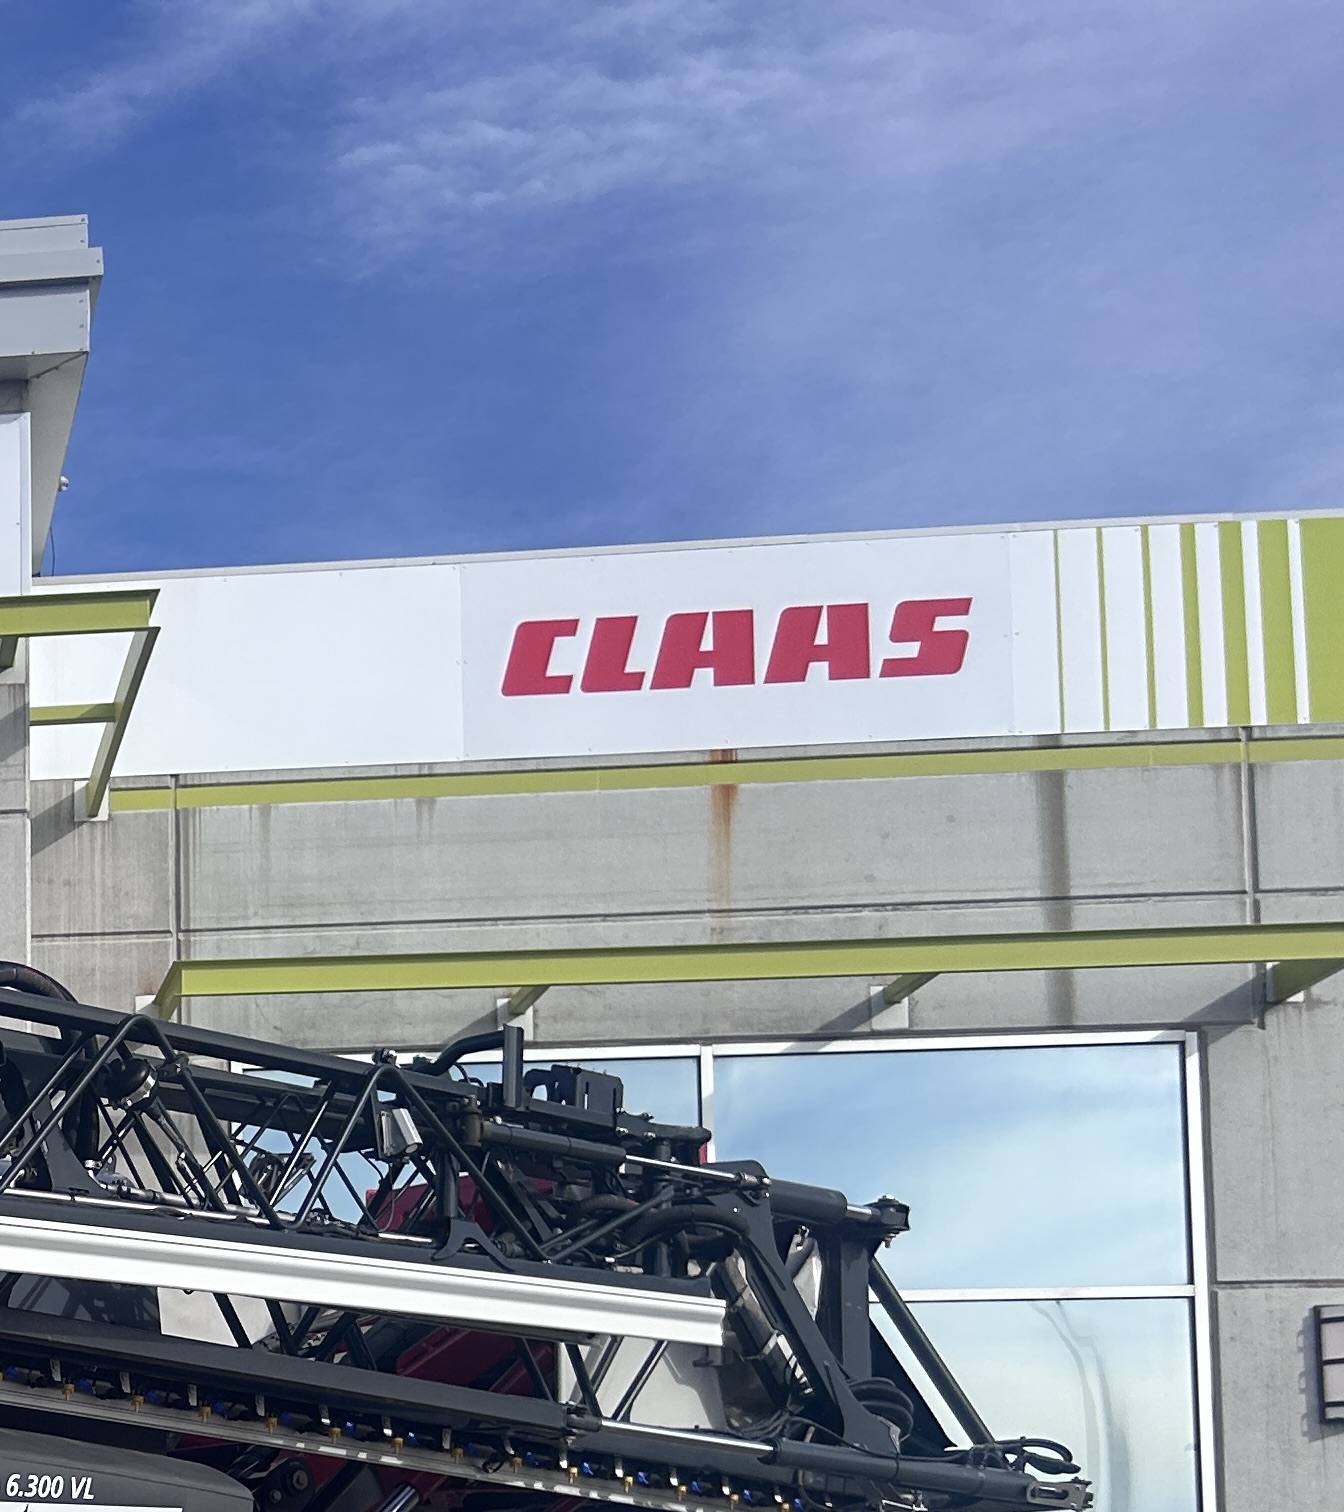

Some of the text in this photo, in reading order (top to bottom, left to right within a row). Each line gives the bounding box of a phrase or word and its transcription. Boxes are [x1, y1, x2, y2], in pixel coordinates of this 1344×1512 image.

[501, 597, 974, 697] CLAAS
[5, 1473, 64, 1500] 6.300
[69, 1476, 95, 1500] VL
